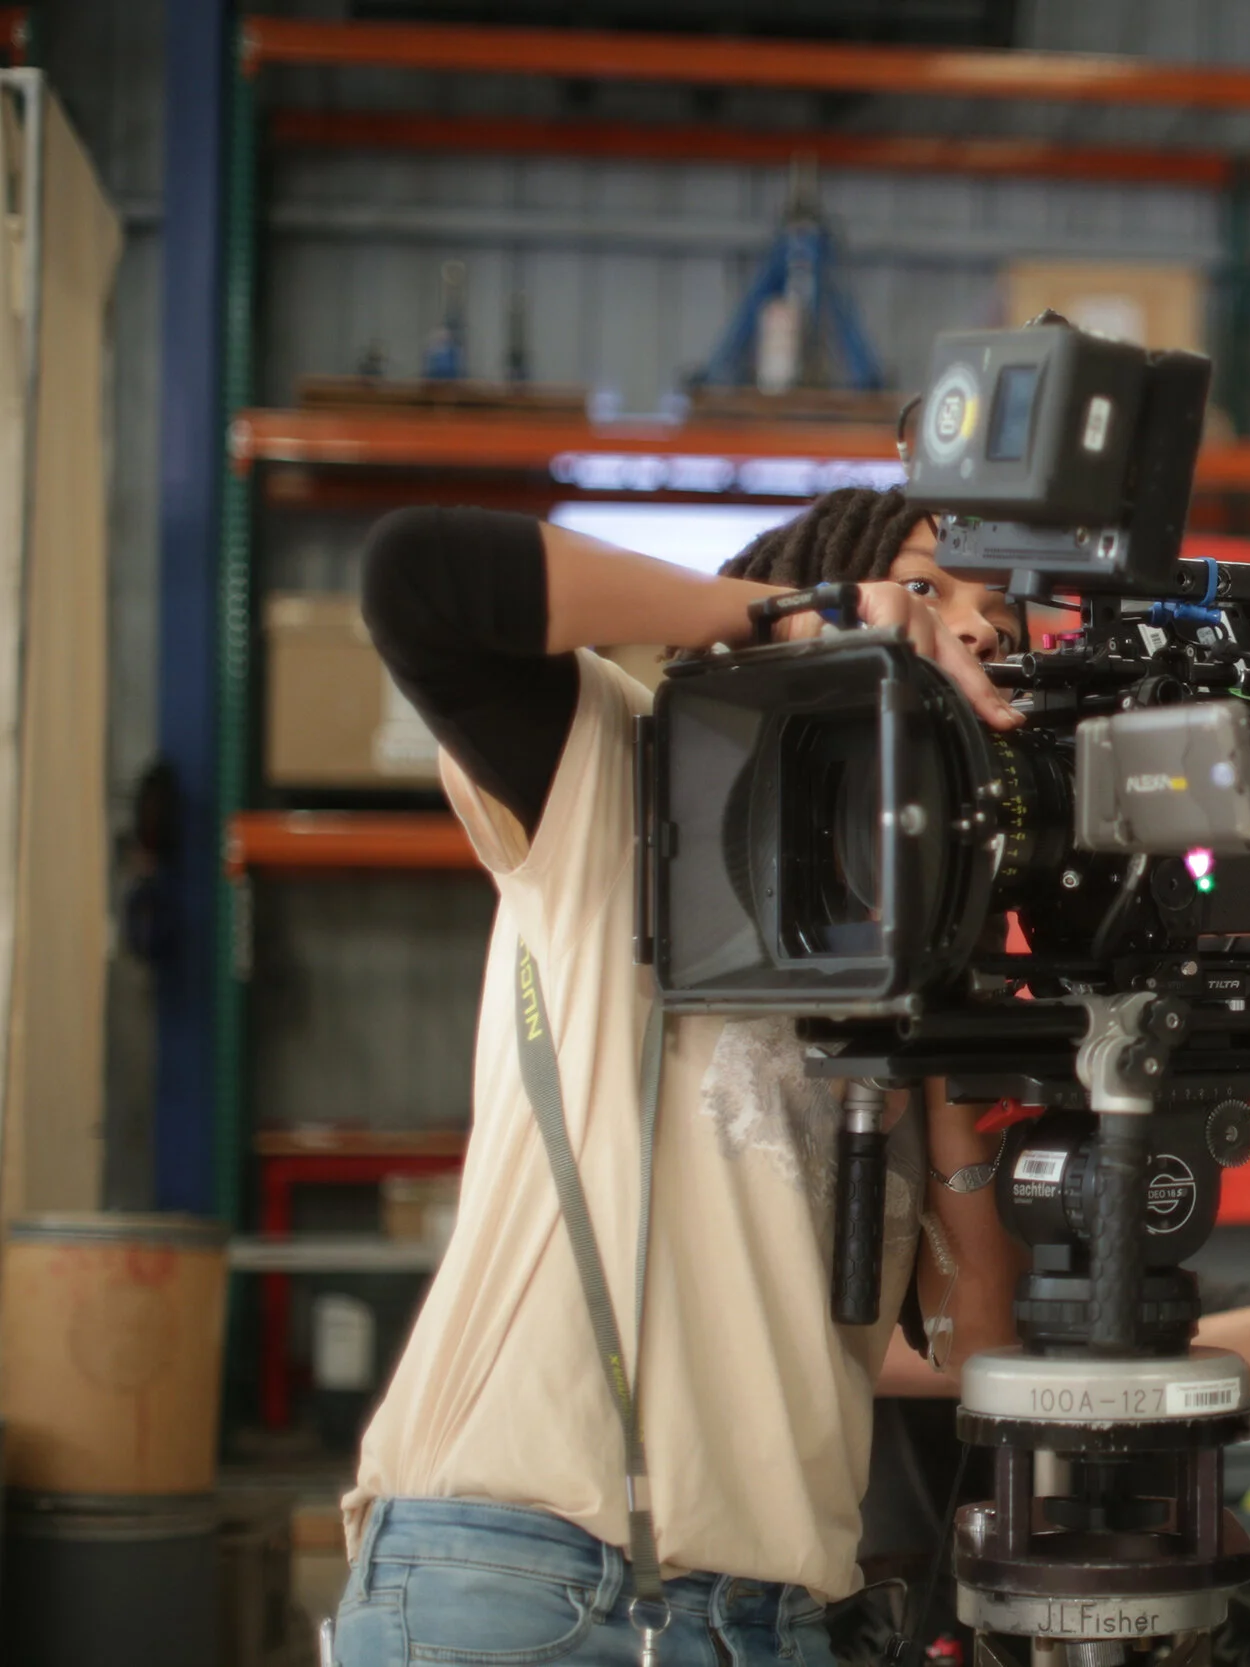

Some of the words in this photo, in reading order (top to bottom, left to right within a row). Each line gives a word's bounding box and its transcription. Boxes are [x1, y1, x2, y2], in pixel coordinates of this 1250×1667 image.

[1208, 980, 1241, 989] TILTA
[1013, 1182, 1056, 1198] sachtler
[1030, 1388, 1165, 1414] 100A-127
